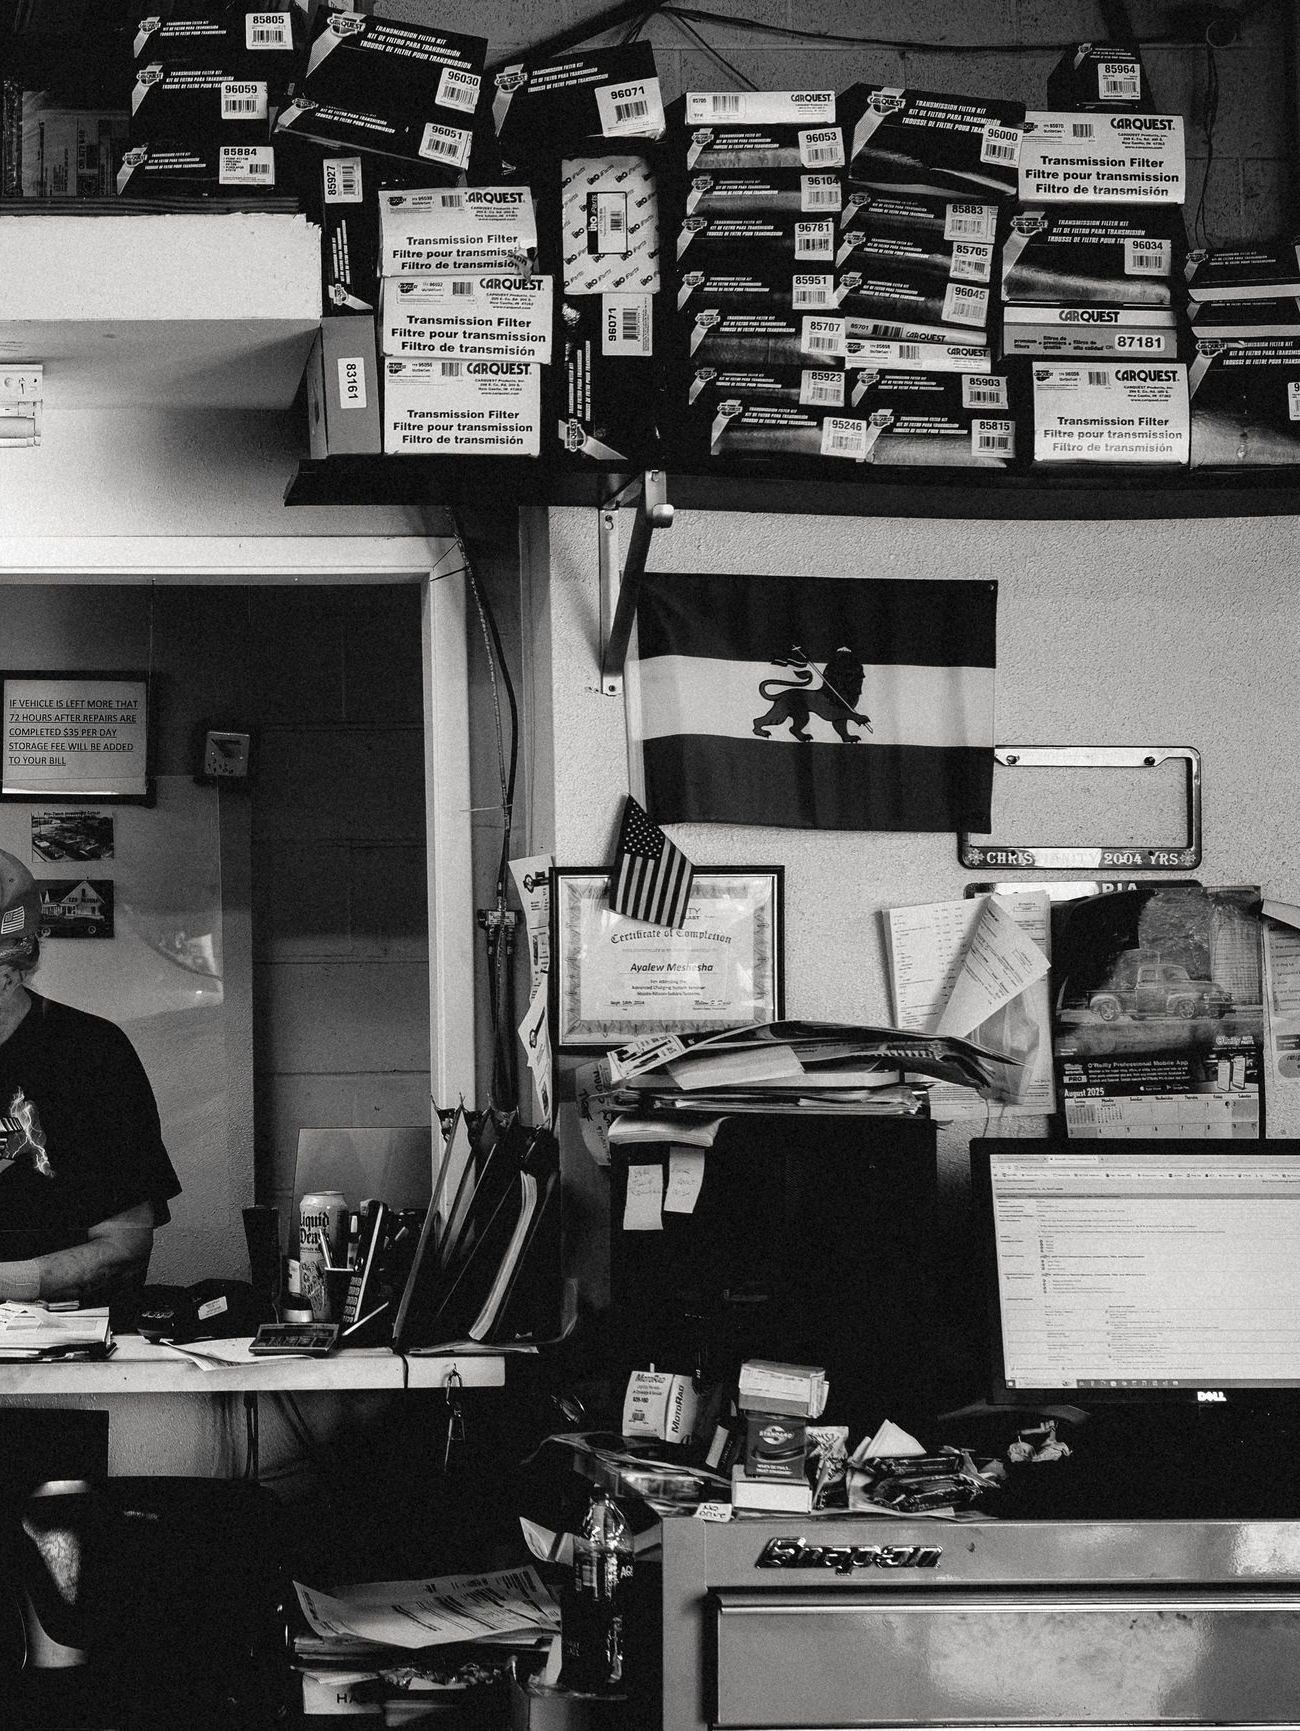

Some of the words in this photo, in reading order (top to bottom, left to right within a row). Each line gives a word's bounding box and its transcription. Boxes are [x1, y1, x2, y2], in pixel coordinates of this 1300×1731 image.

[252, 15, 285, 25] 85805
[367, 32, 378, 41] KIT
[385, 36, 405, 46] FILTRO
[404, 40, 421, 50] PARA
[375, 25, 418, 40] TRANSMISSION
[417, 33, 436, 44] FILTER
[436, 37, 448, 46] KIT
[360, 39, 386, 52] TROUSSE
[393, 47, 413, 57] FILTRE
[412, 51, 428, 60] POUR
[428, 54, 473, 70] TRANSMISSION
[1104, 64, 1136, 74] 85964
[447, 71, 479, 87] 96030
[225, 84, 258, 94] 96059
[610, 86, 646, 100] 96071
[790, 93, 833, 103] CARQUEST
[1110, 117, 1176, 131] CARQUEST
[431, 125, 463, 141] 96051
[805, 132, 838, 144] 96053
[987, 127, 1019, 142] 96000
[223, 147, 257, 156] 85884
[1040, 155, 1126, 168] Transmission
[1129, 157, 1165, 169] Filter
[327, 165, 337, 196] 85927
[807, 176, 840, 186] 96104
[1025, 169, 1060, 180] Filtre
[1062, 172, 1093, 183] pour
[1095, 171, 1180, 183] transmission
[1035, 183, 1070, 195] Filtro
[1073, 184, 1090, 195] de
[1092, 184, 1169, 197] transmisión
[951, 204, 984, 215] 85883
[798, 223, 831, 233] 96781
[406, 235, 484, 247] Transmission
[486, 234, 519, 245] Filter
[1132, 240, 1164, 251] 96034
[392, 250, 424, 260] Filtre
[426, 250, 454, 261] pour
[955, 244, 989, 258] 85705
[401, 261, 433, 271] Filtro
[435, 260, 450, 270] de
[479, 277, 545, 292] CARQUEST
[794, 276, 828, 286] 85951
[954, 286, 986, 300] 96045
[406, 315, 493, 328] Transmission
[496, 317, 532, 329] Filter
[1058, 309, 1121, 324] CARQUEST
[608, 307, 617, 342] 96071
[809, 321, 842, 333] 85707
[391, 328, 426, 338] Filtre
[428, 330, 459, 340] pour
[462, 331, 547, 343] transmission
[905, 330, 947, 343] CARQUEST
[1116, 335, 1163, 349] 87181
[401, 341, 436, 352] Filtro
[439, 342, 455, 353] de
[459, 342, 536, 357] transmisión
[946, 347, 989, 358] CARQUEST
[466, 362, 533, 376] CARQUEST
[345, 362, 359, 401] 83161
[811, 371, 843, 383] 85923
[969, 377, 1001, 387] 85903
[1114, 369, 1180, 383] CARQUEST
[406, 409, 485, 420] Transmission
[488, 410, 520, 421] Filter
[831, 419, 863, 432] 95246
[979, 420, 1011, 432] 85815
[1056, 416, 1135, 427] Transmission
[1138, 417, 1170, 427] Filter
[393, 422, 425, 432] Filtre
[427, 423, 454, 434] pour
[457, 423, 534, 433] transmission
[402, 435, 433, 445] Filtro
[436, 435, 451, 445] de
[454, 434, 524, 446] transmisión
[1043, 429, 1075, 440] Filtre
[1077, 431, 1105, 441] pour
[1106, 430, 1184, 440] transmission
[1052, 442, 1084, 453] Filtro
[1085, 442, 1102, 453] de
[1104, 442, 1174, 453] transmisión
[9, 699, 17, 709] IF
[19, 699, 54, 709] VEHICLE
[56, 699, 64, 709] IS
[65, 699, 85, 709] LEFT
[87, 699, 113, 709] MORE
[115, 699, 138, 709] THAT
[9, 713, 20, 723] 72
[22, 713, 52, 723] HOURS
[54, 713, 81, 723] AFTER
[83, 713, 118, 723] REPAIRS
[119, 713, 137, 723] ARE
[9, 727, 61, 737] COMPLETED
[63, 727, 79, 737] $35
[81, 727, 97, 737] PER
[99, 727, 117, 737] DAY
[8, 742, 49, 751] STORAGE
[51, 742, 65, 751] FEE
[67, 742, 89, 751] WILL
[91, 742, 101, 751] BE
[104, 742, 134, 751] ADDED
[9, 756, 21, 765] TO
[22, 756, 47, 765] YOUR
[49, 756, 67, 765] BILL
[1103, 852, 1143, 866] 2004
[1149, 852, 1179, 866] YRS
[611, 930, 661, 944] Certificate
[664, 928, 674, 938] of
[676, 930, 732, 944] Completion
[630, 962, 665, 973] Ayalew
[1064, 1088, 1087, 1099] August
[1087, 1087, 1105, 1098] 2025
[1197, 1391, 1227, 1402] DELL
